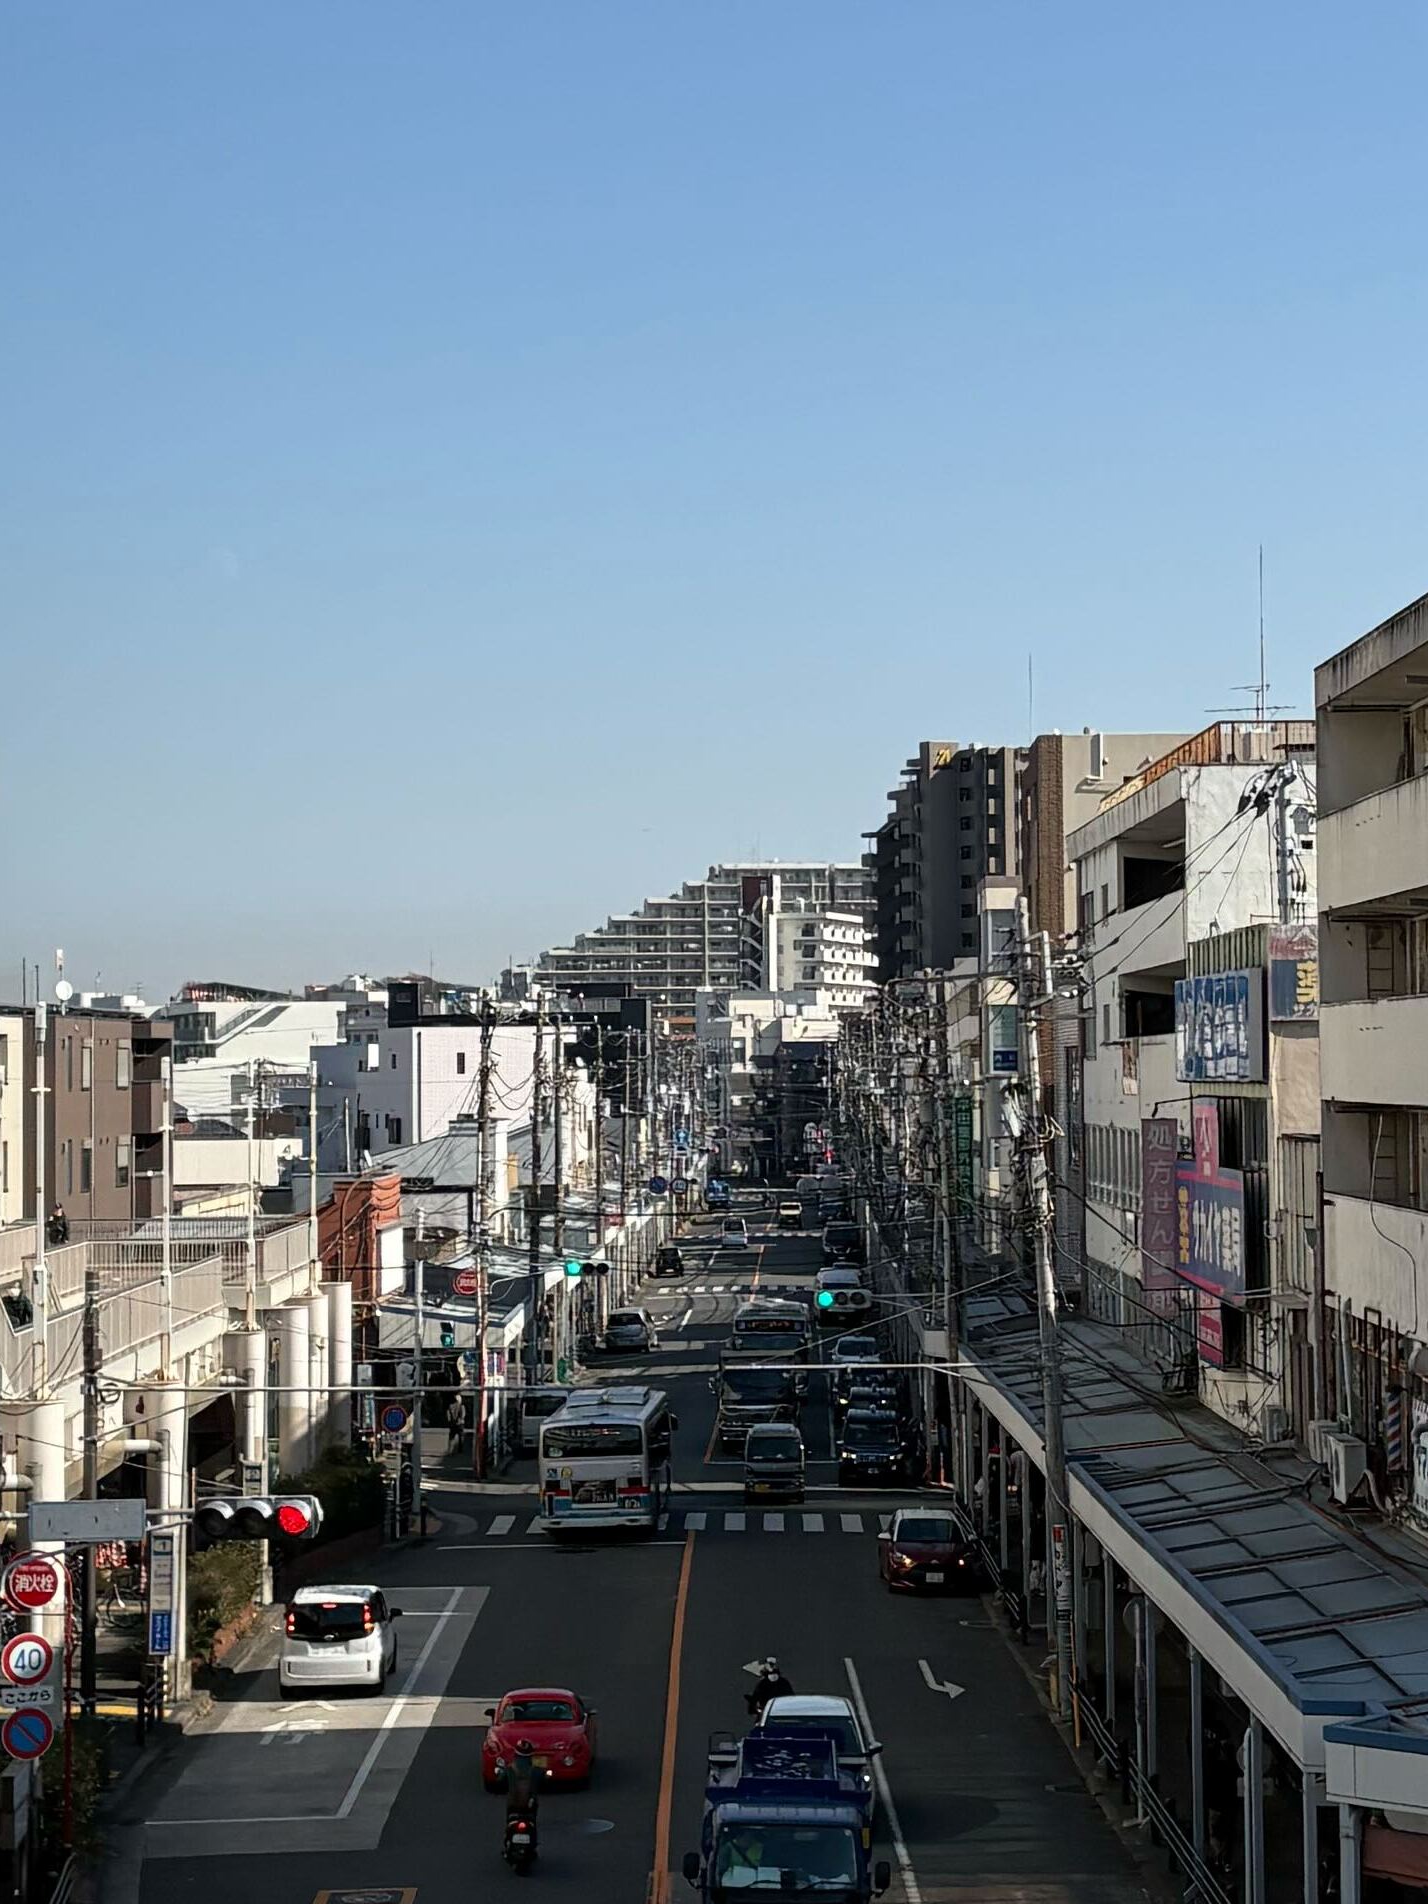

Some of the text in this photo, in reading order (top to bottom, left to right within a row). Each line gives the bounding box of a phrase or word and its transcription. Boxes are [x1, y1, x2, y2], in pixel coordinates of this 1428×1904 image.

[15, 1572, 55, 1593] 消火栓
[15, 1648, 42, 1671] 40
[4, 1690, 52, 1705] ここから
